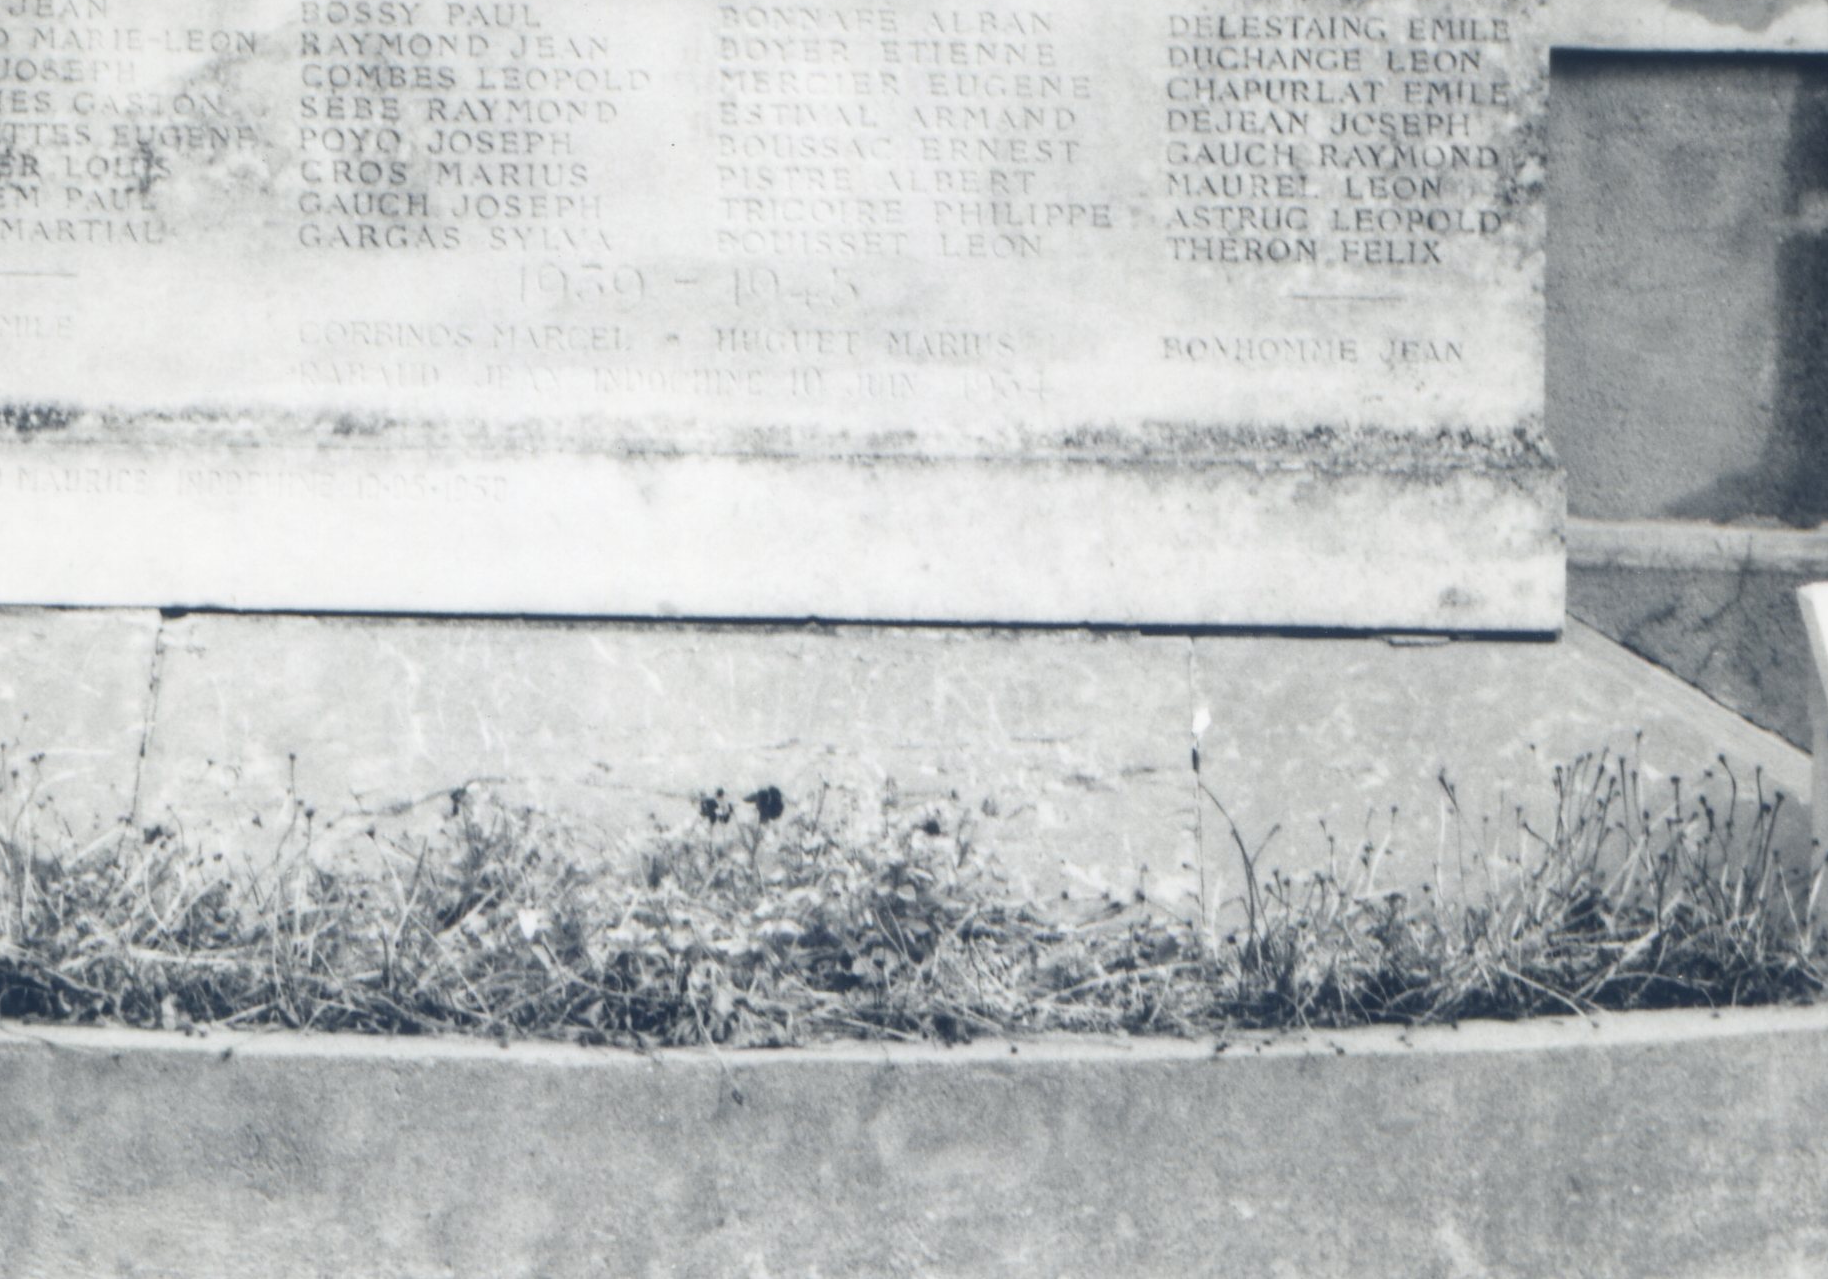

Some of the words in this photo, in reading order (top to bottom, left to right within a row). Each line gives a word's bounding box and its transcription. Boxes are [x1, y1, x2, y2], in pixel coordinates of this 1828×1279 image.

[301, 1, 422, 25] BOSSY
[446, 3, 541, 28] PAUL
[928, 11, 1052, 35] ALBAN
[1409, 18, 1511, 42] EMILE
[300, 32, 490, 59] RAYMOND
[510, 35, 609, 60] JEAN
[720, 37, 849, 63] BOYER
[881, 41, 1056, 67] ETIENNE
[1168, 46, 1361, 72] DUCHANGE
[1386, 49, 1482, 73] LEON
[301, 64, 456, 90] COMBES
[478, 67, 652, 92] LEOPOLD
[720, 69, 900, 95] MERCIER
[928, 73, 1091, 100] EUGENE
[1166, 77, 1384, 104] CHAPURLAT
[1404, 82, 1509, 106] EMILE
[73, 91, 226, 116] GASTON
[427, 99, 618, 124] RAYMOND
[720, 101, 878, 126] ESTIVAL
[913, 105, 1076, 131] ARMAND
[1330, 113, 1469, 136] JOSEPH
[299, 127, 402, 154] POYO
[426, 131, 572, 155] JOSEPH
[718, 134, 892, 159] BOUSSAC
[921, 138, 1080, 164] ERNEST
[65, 155, 173, 180] LOUIS
[1166, 142, 1294, 166] GAUCH
[1320, 144, 1499, 169] RAYMOND
[300, 161, 407, 186] CROS
[436, 163, 588, 188] MARIUS
[717, 165, 851, 191] PISTRE
[888, 169, 1036, 194] ALBERT
[1166, 174, 1318, 198] MAUREL
[1345, 176, 1443, 200] LEON
[65, 185, 156, 212] PAUL
[298, 192, 428, 217] GAUCH
[452, 194, 601, 219] JOSEPH
[721, 197, 902, 224] TRICOIRE
[934, 200, 1112, 229] PHILIPPE
[1166, 205, 1309, 231] ASTRUC
[1333, 209, 1502, 235] LEOPOLD
[0, 218, 164, 245] MARTIAL
[298, 224, 461, 250] GARGAS
[941, 233, 1043, 258] LEON
[1167, 239, 1317, 263] THERON
[1342, 241, 1442, 265] FELIX
[492, 323, 634, 352] MARCEL
[886, 330, 1016, 358] MARIUS
[1380, 338, 1465, 365] JEAN
